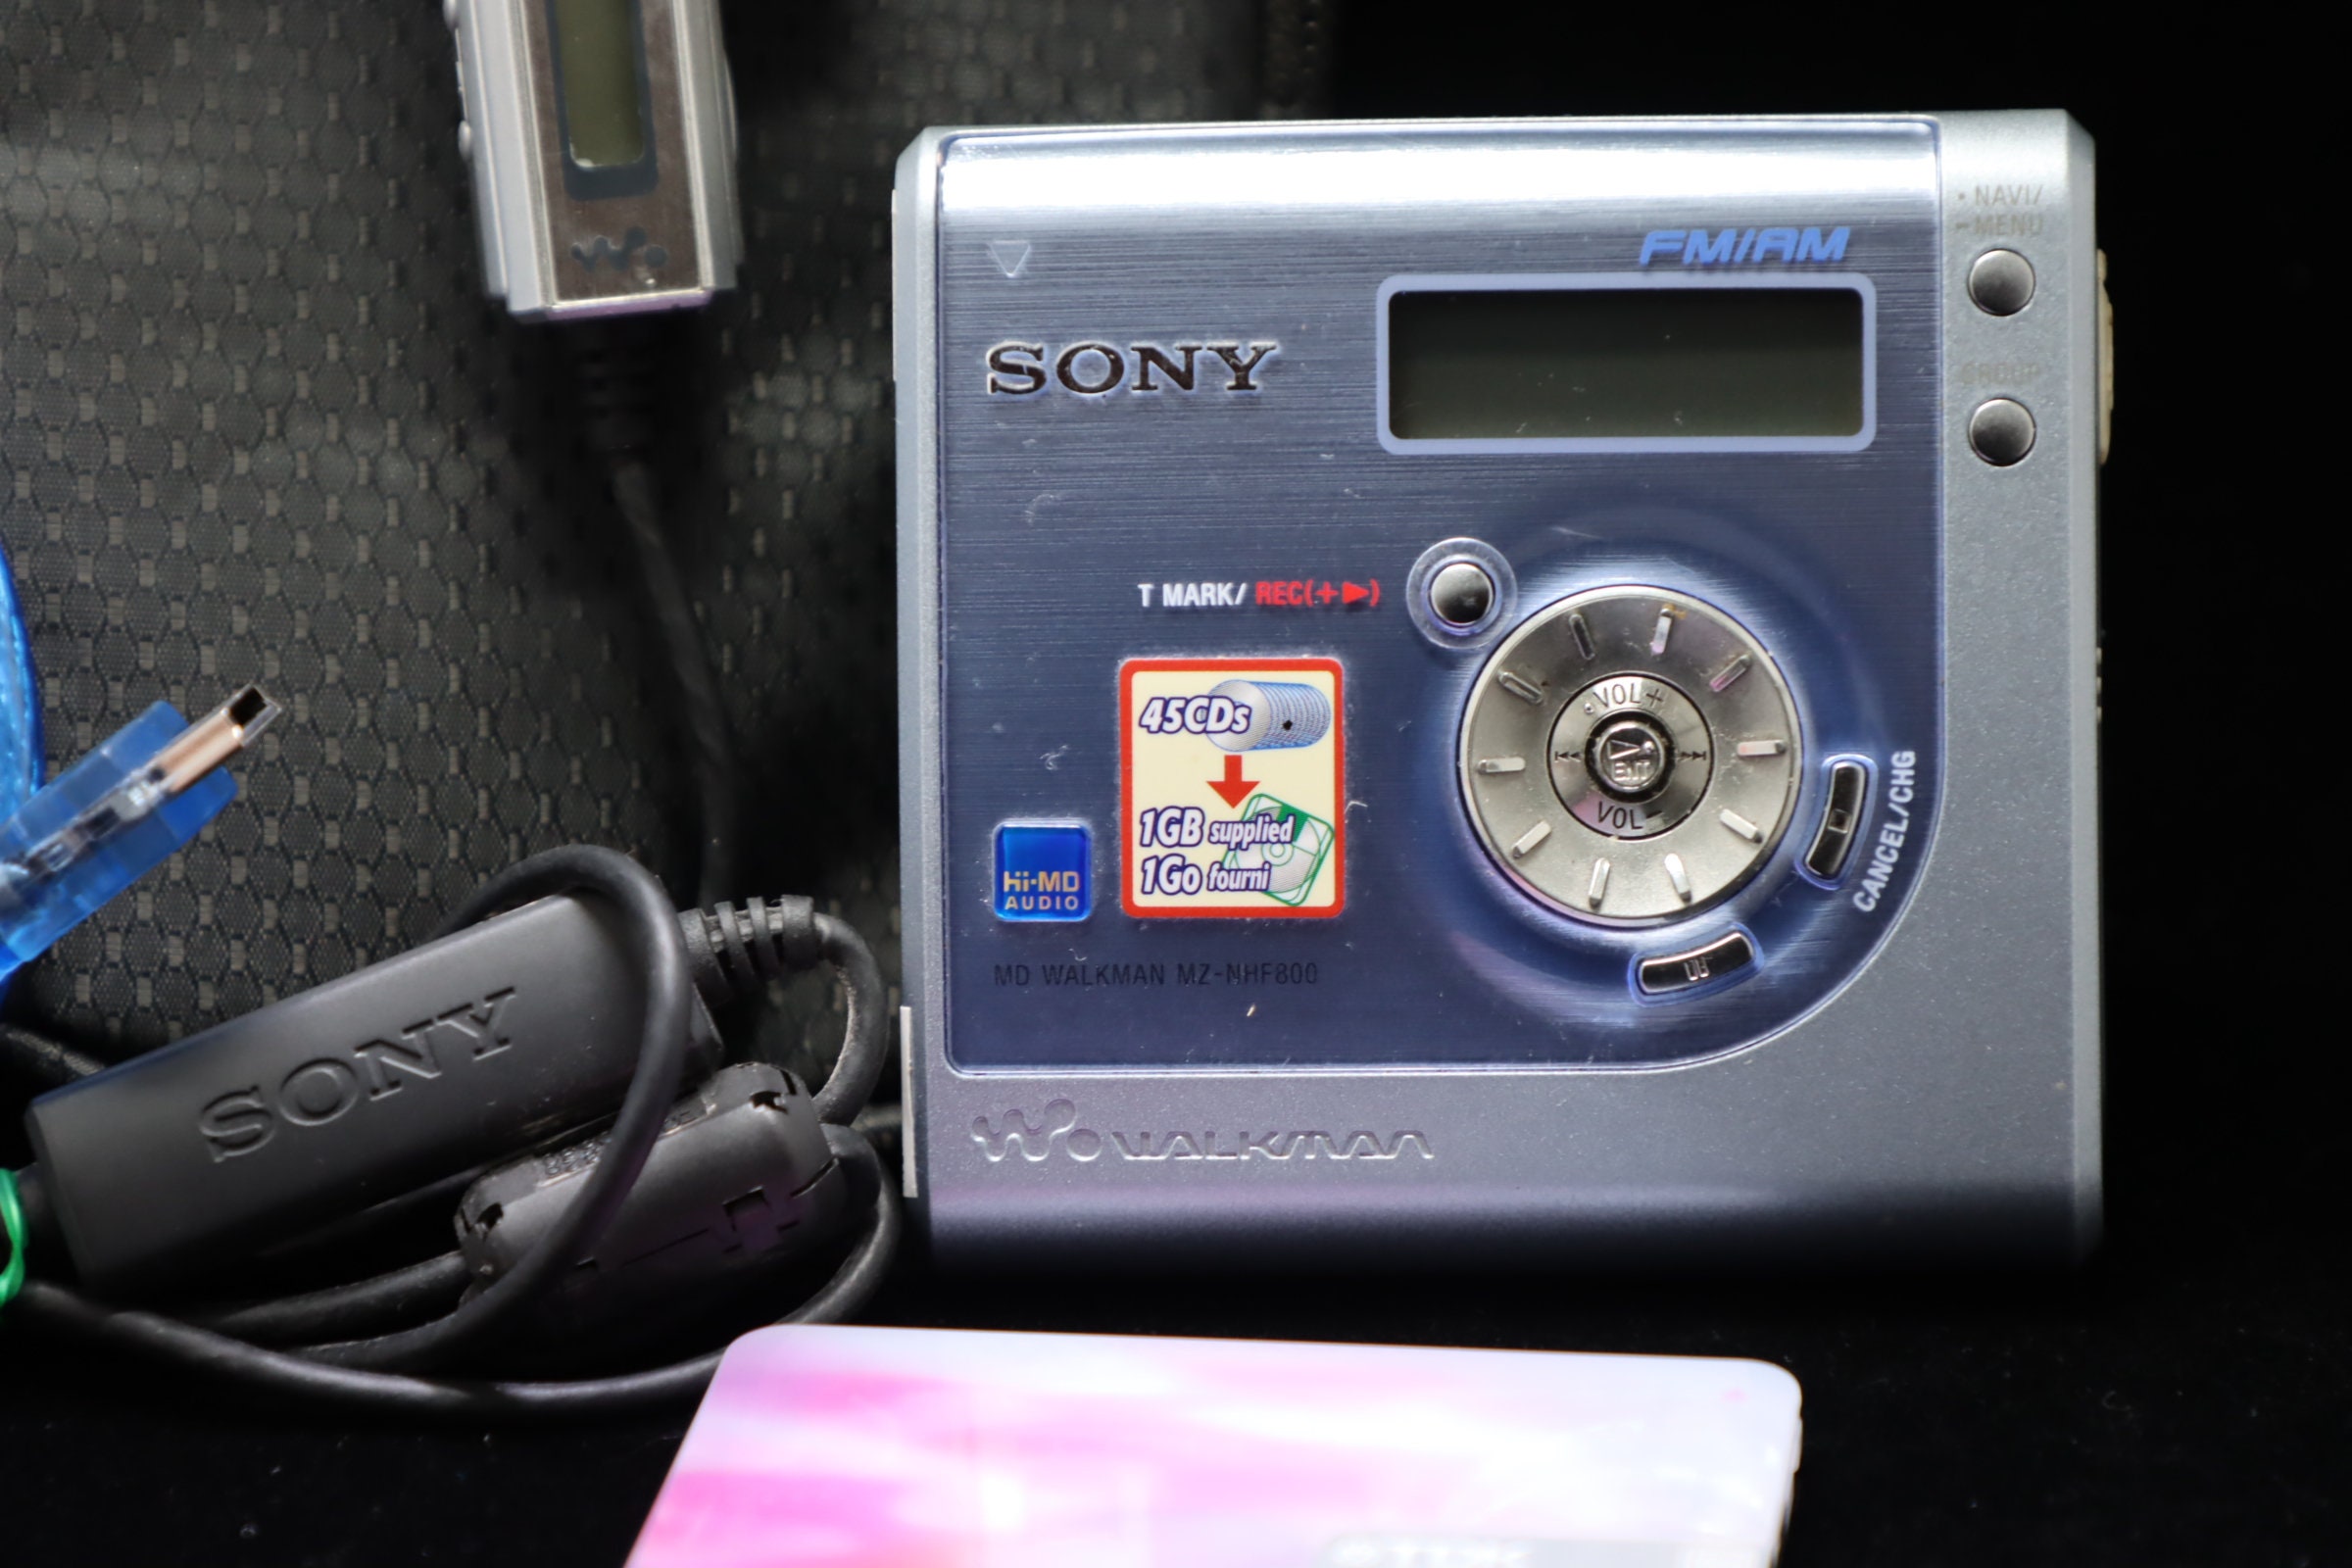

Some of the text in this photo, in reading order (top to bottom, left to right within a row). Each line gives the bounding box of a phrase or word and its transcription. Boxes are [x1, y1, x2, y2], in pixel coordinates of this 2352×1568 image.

[1974, 184, 2043, 206] NAVI/
[1974, 214, 2044, 236] MENU
[1640, 227, 1850, 266] FM/AM
[986, 340, 1277, 394] SONY
[1138, 583, 1154, 607] T
[1162, 582, 1247, 607] MARK/
[1139, 695, 1252, 734] 45CDs
[1140, 807, 1295, 850] 1GB supplied
[1853, 750, 1916, 913] CANCEL/CHG
[1004, 870, 1080, 893] Hi-MD
[1141, 854, 1271, 895] 1Go fourni
[1004, 896, 1079, 910] AUDIO
[994, 961, 1318, 987] MD WALKMAN MZ-NHF800
[199, 986, 516, 1165] SONY
